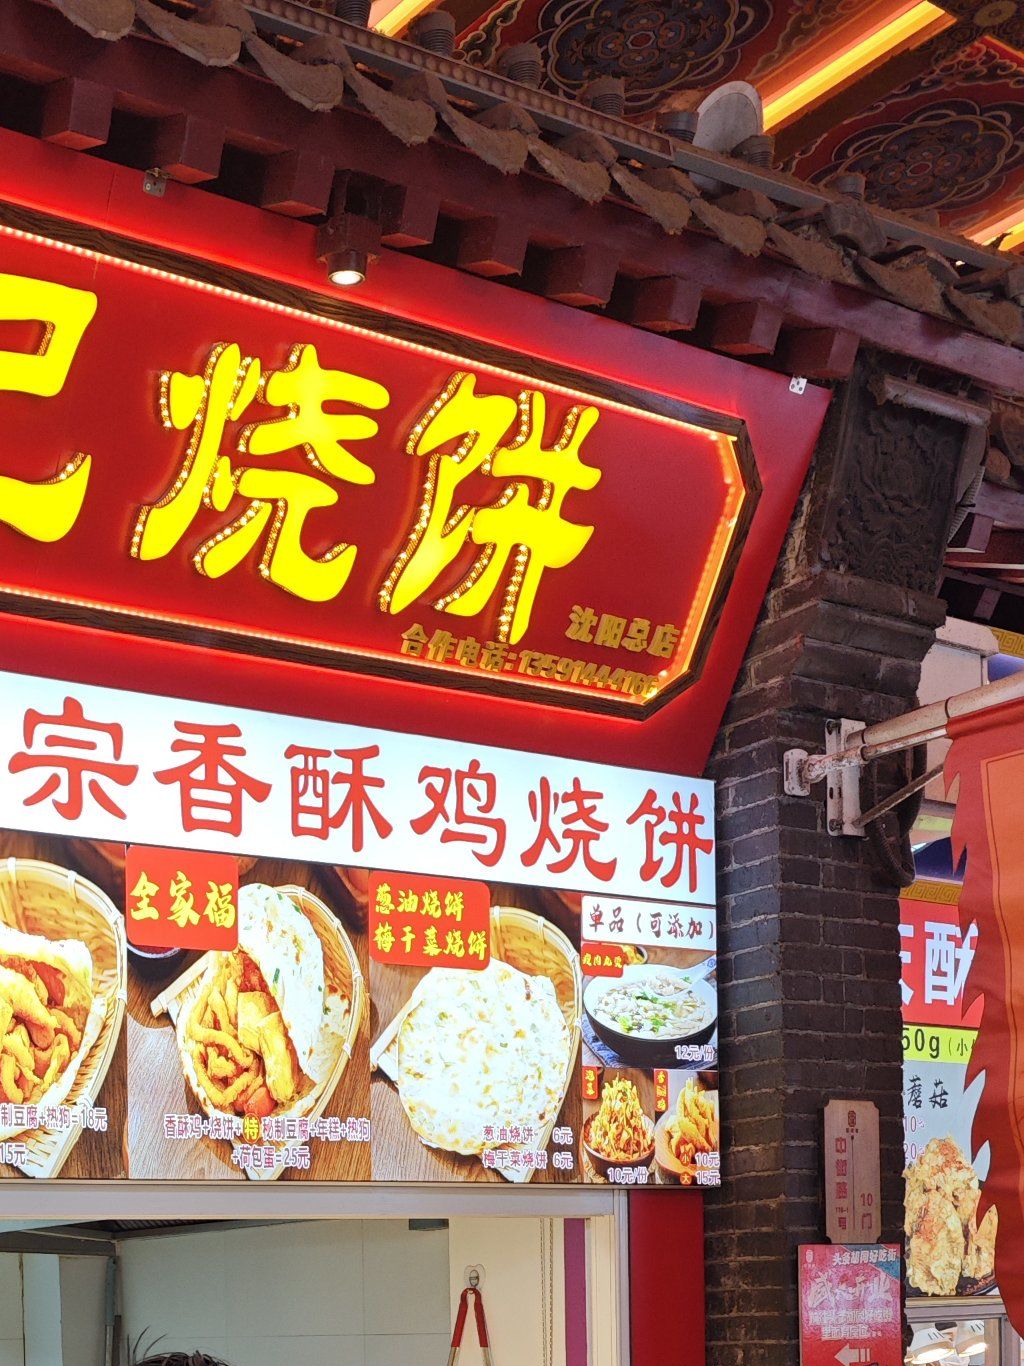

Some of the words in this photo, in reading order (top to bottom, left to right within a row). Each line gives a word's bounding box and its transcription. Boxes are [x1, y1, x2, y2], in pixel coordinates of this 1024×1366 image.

[565, 605, 679, 658] 沈阳总店
[130, 871, 236, 929] 全家福
[375, 883, 464, 921] 葱油烧饼
[373, 921, 488, 960] 梅干菜烧饼
[674, 1045, 715, 1061] 12元/份
[553, 1127, 573, 1145] 6元
[553, 1151, 574, 1169] 6元
[607, 1167, 650, 1184] 10元/份
